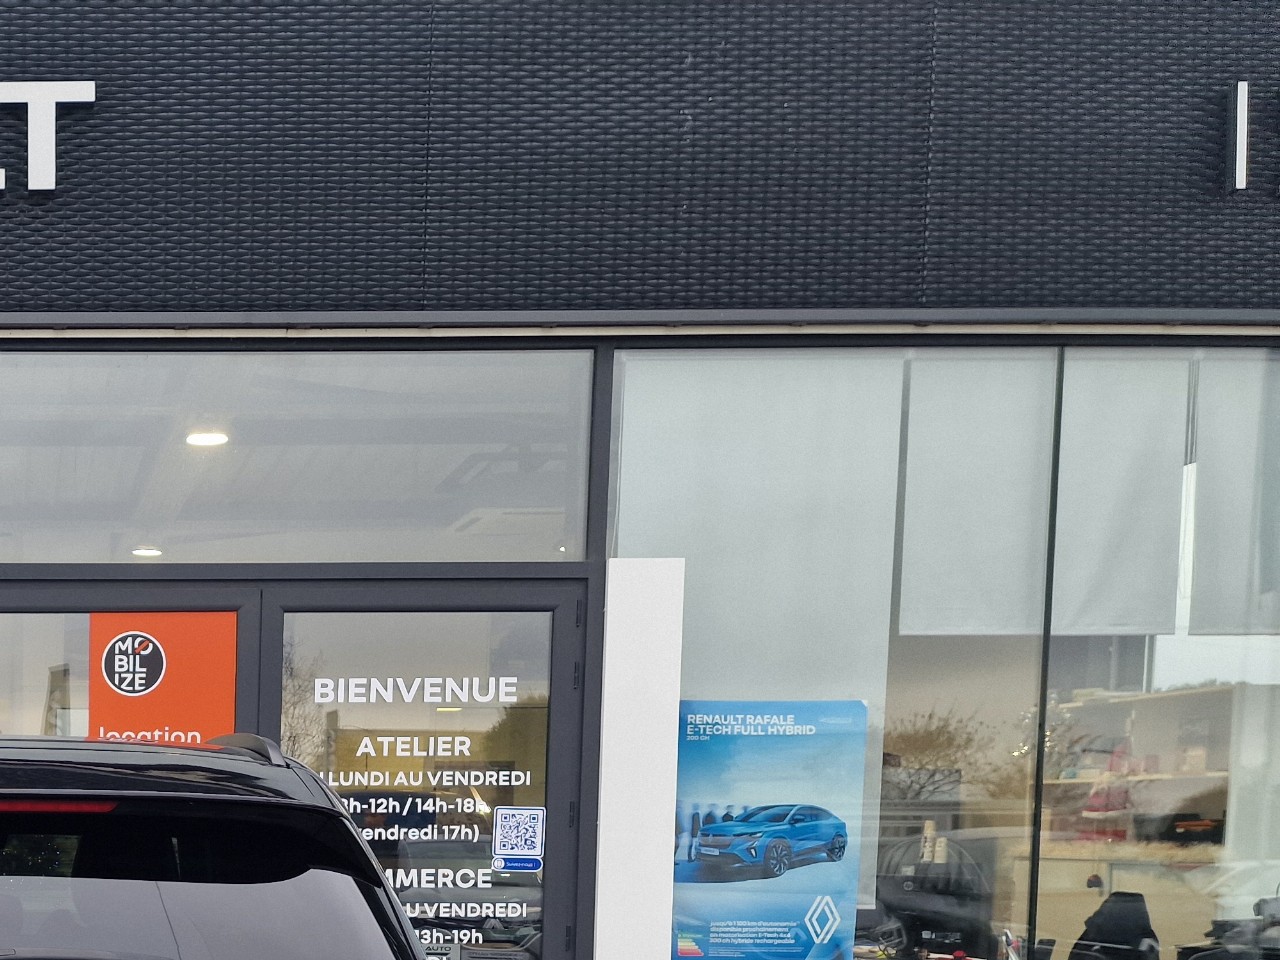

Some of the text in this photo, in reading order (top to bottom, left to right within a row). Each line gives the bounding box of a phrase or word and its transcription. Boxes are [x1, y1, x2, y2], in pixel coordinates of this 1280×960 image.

[314, 678, 518, 703] BIENVENUE
[687, 714, 795, 724] RENAULT RAFALE
[686, 725, 816, 735] E-TECH FULL HYBRID
[356, 737, 471, 757] ATELIER
[328, 771, 389, 786] LUNDI
[394, 771, 422, 786] AU
[427, 771, 531, 786] VENDREDI
[415, 797, 490, 814] 14h-18h
[359, 824, 480, 843] endredi 17h)
[405, 902, 527, 918] U VENDREDI
